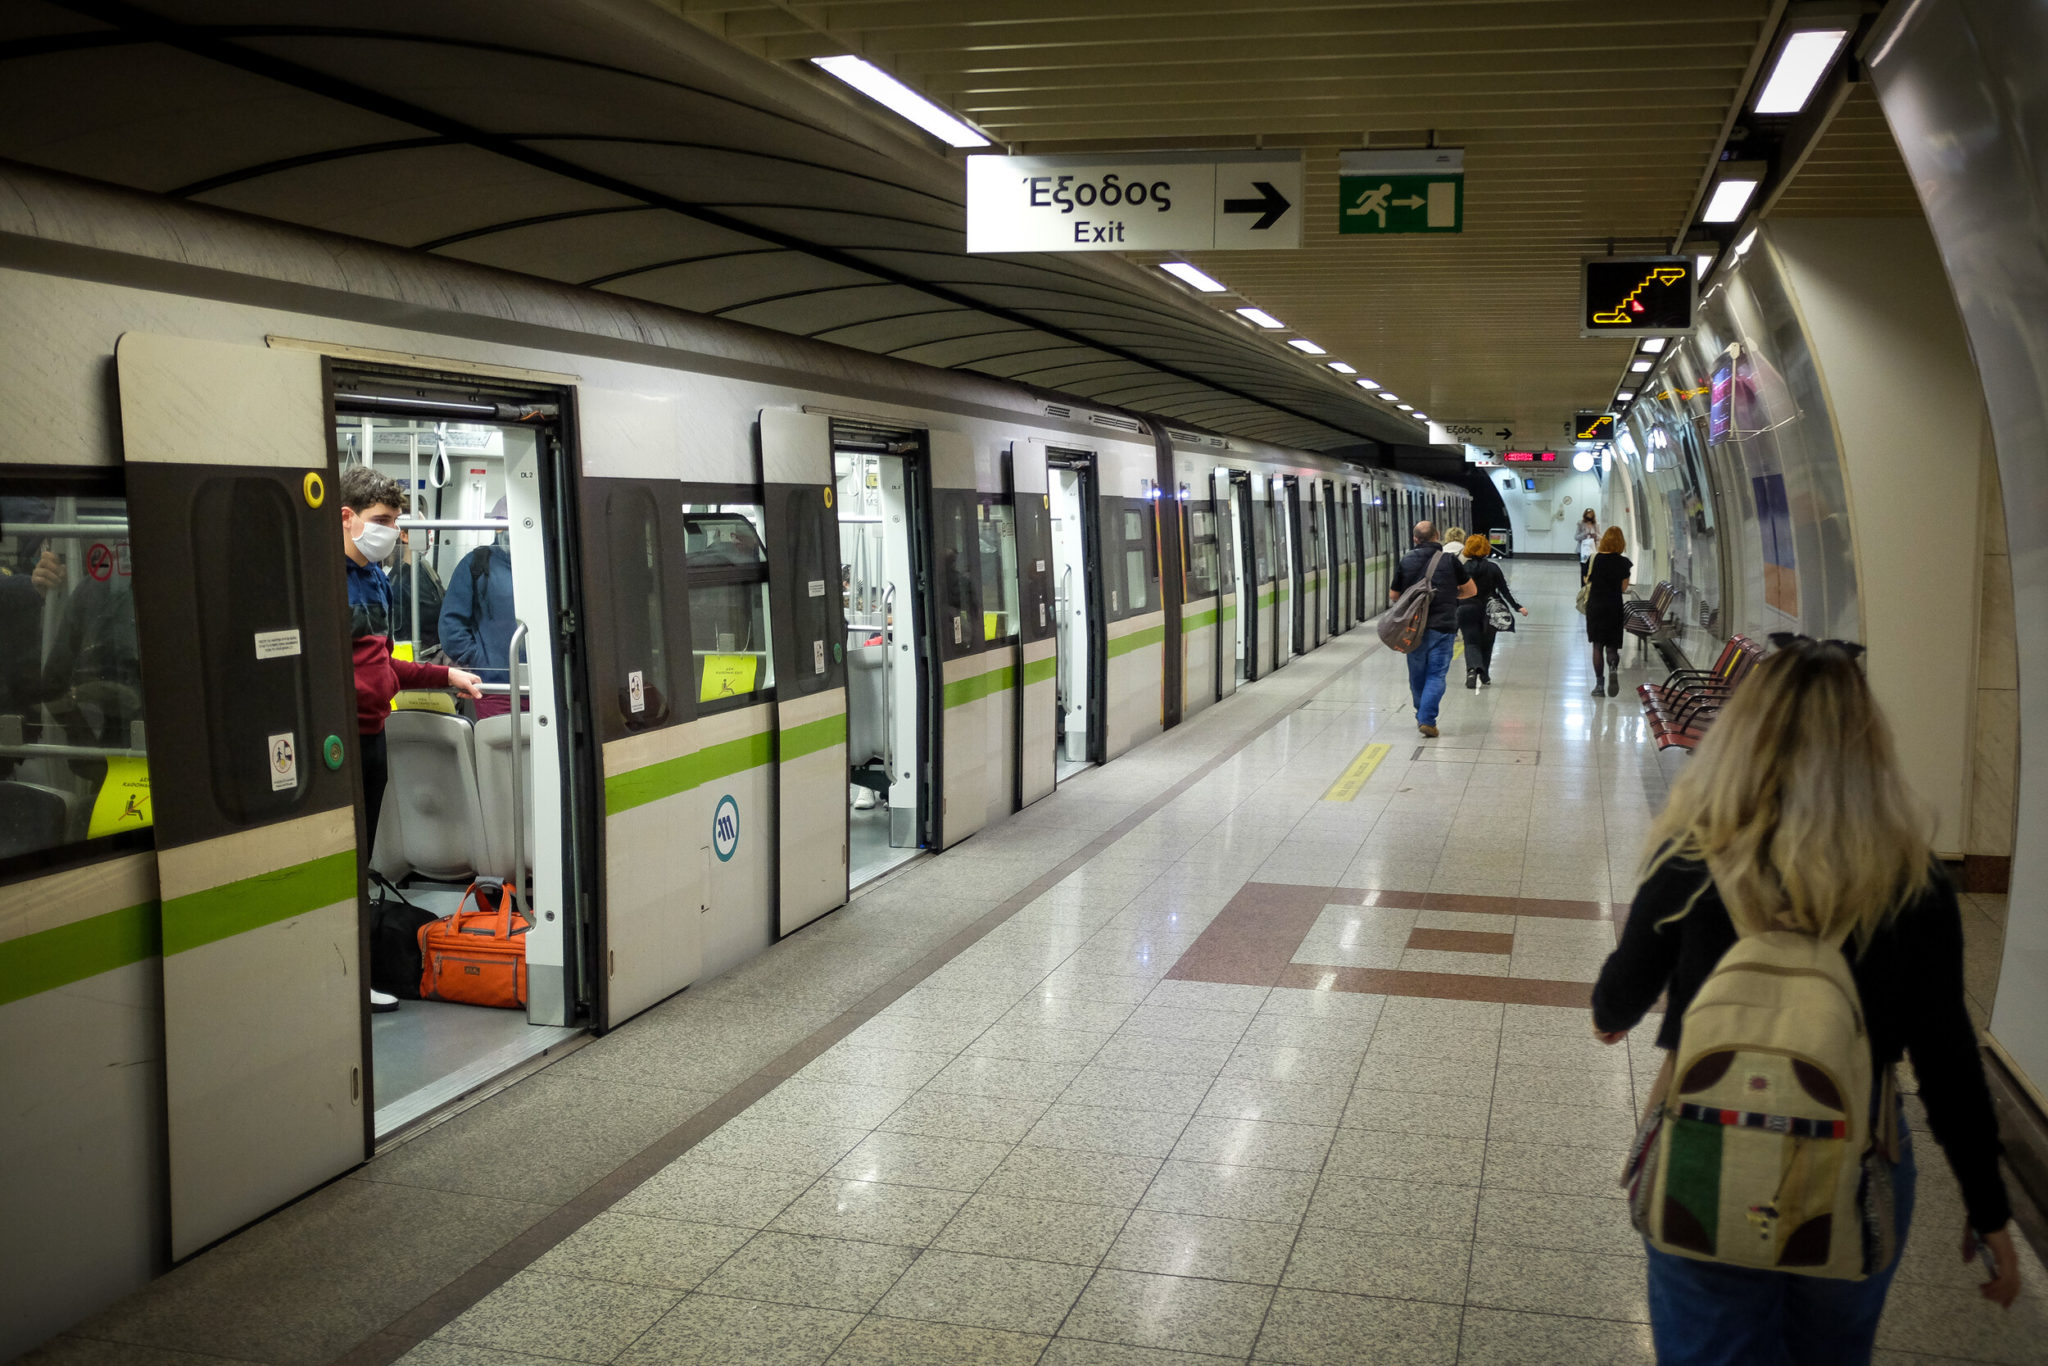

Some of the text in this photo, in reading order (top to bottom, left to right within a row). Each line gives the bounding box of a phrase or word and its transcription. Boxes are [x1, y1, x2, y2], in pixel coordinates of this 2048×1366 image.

[1022, 174, 1171, 213] Έξοδος
[1074, 221, 1125, 243] Exit
[1444, 425, 1483, 435] Έξοδος
